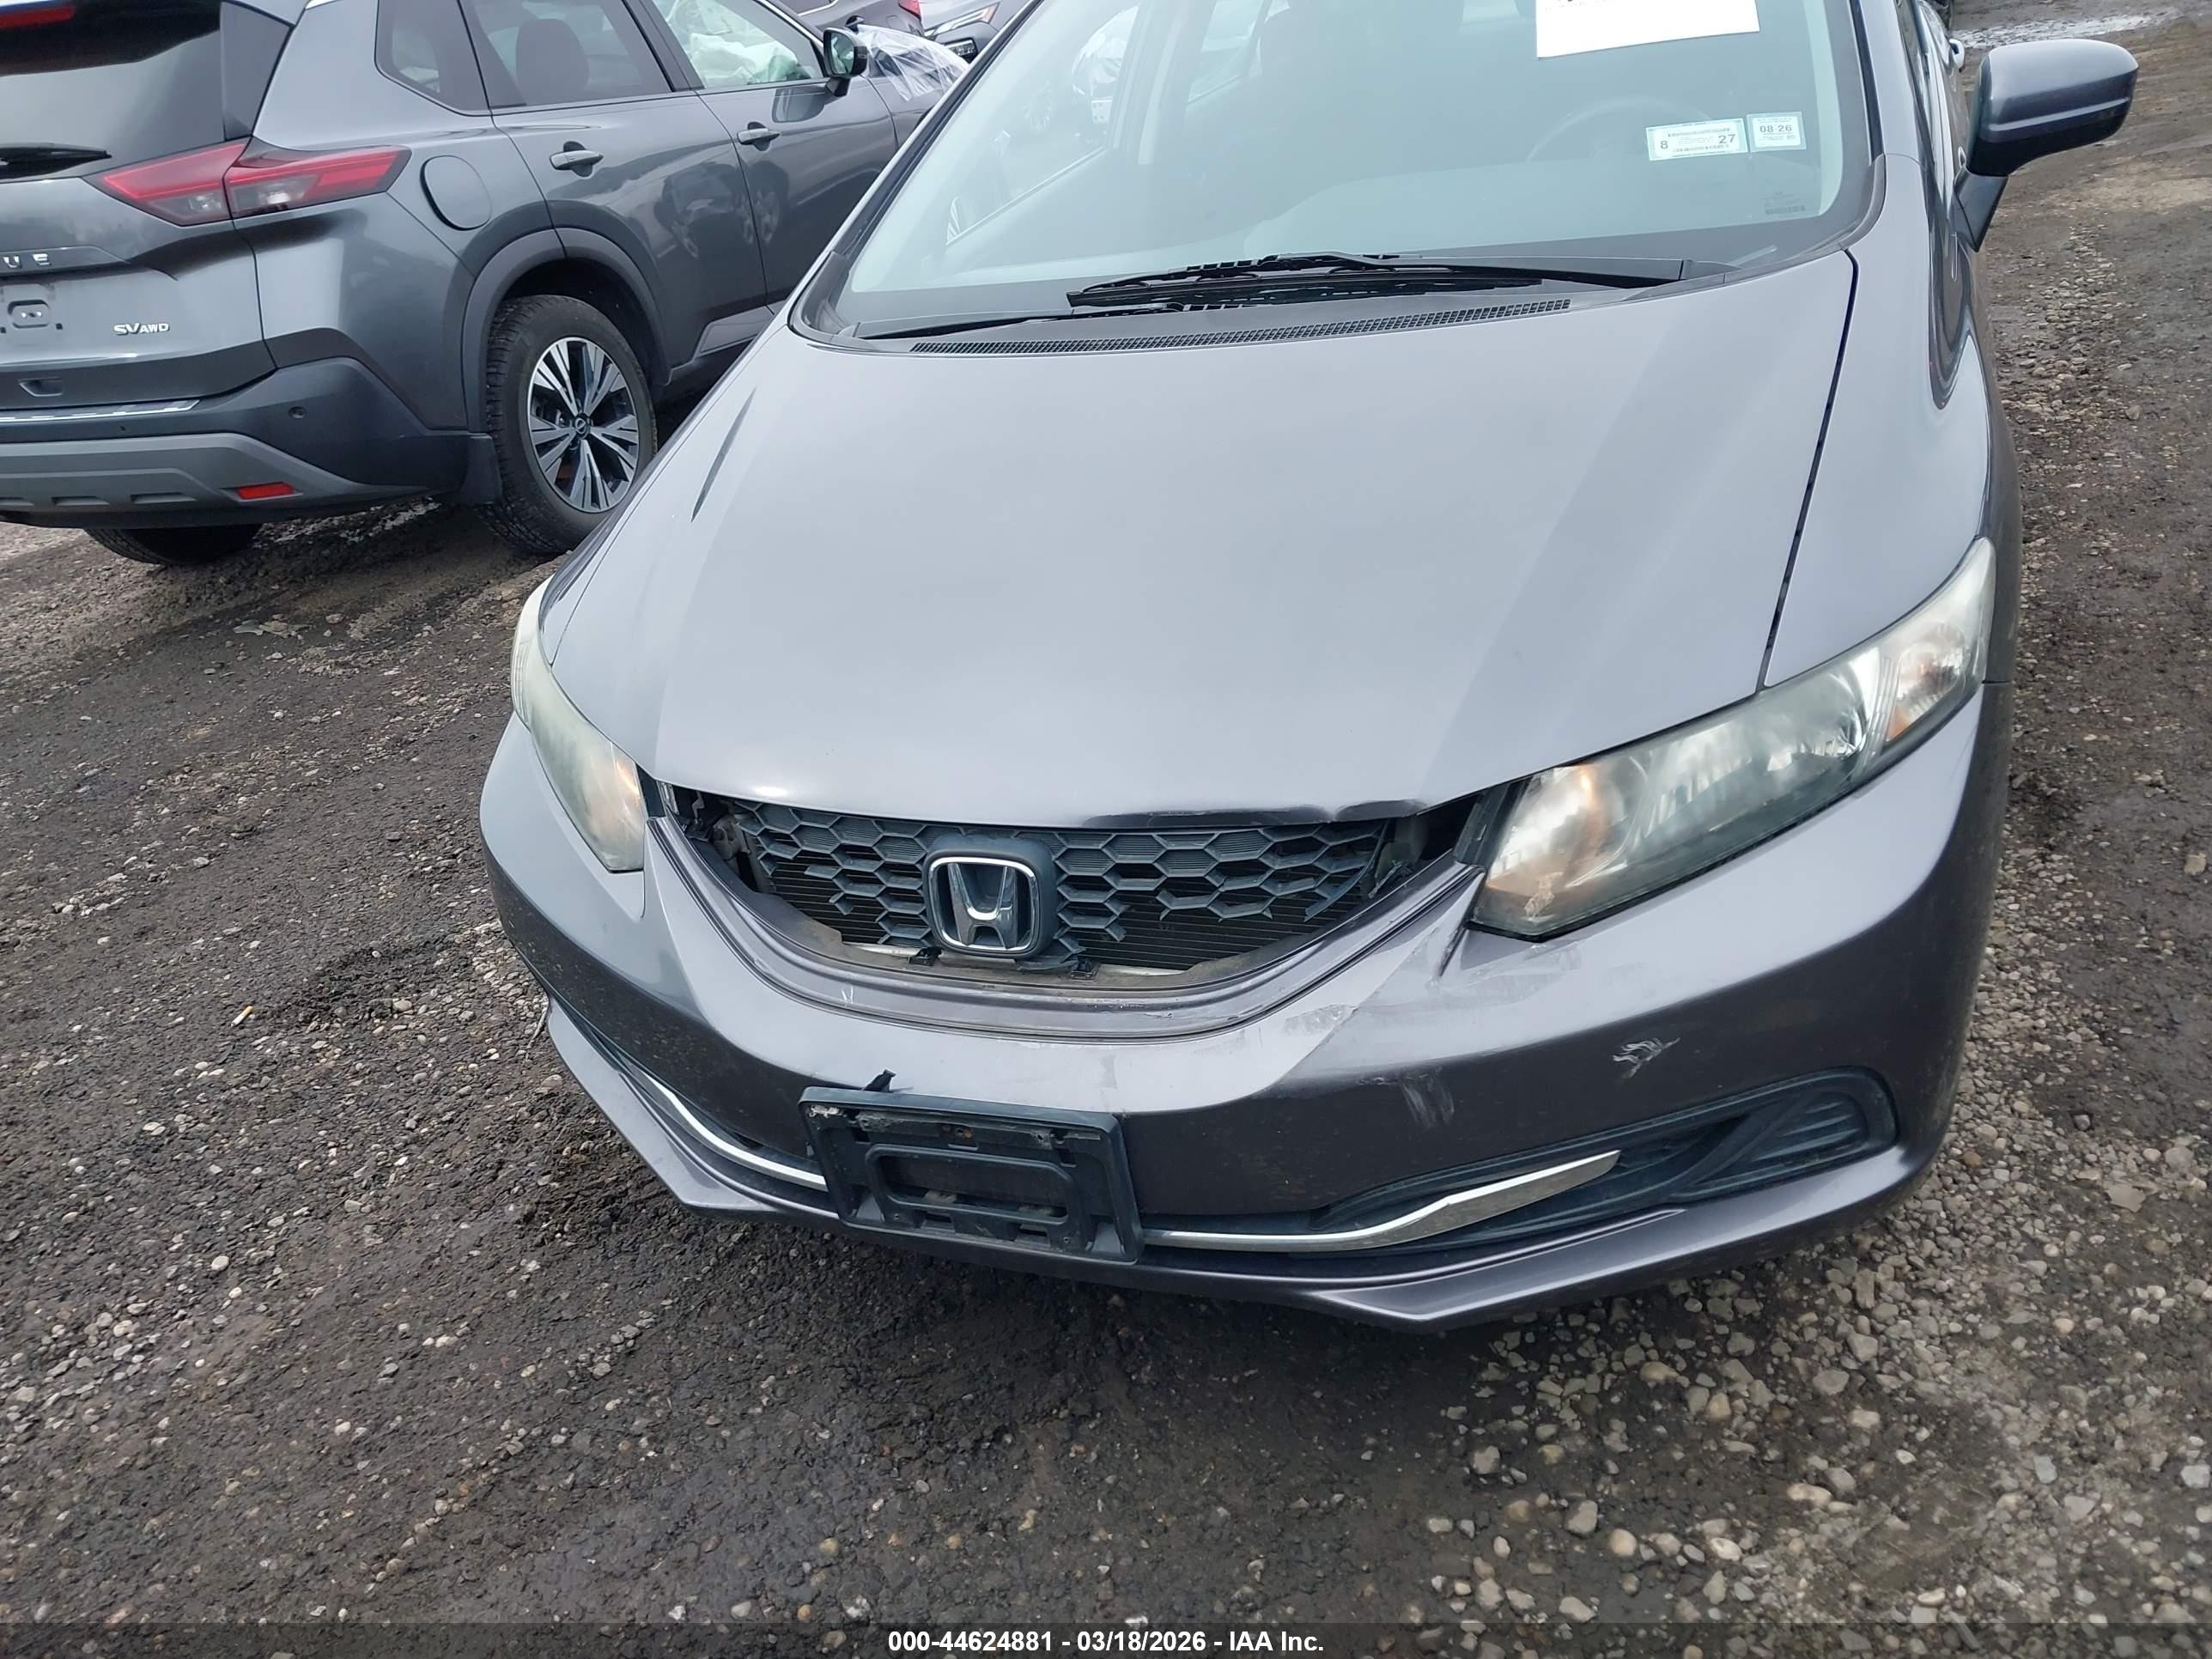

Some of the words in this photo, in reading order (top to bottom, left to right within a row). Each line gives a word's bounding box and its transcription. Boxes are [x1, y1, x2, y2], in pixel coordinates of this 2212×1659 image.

[1778, 124, 1792, 132] 26
[1660, 140, 1668, 149] 8
[1717, 134, 1736, 144] 27
